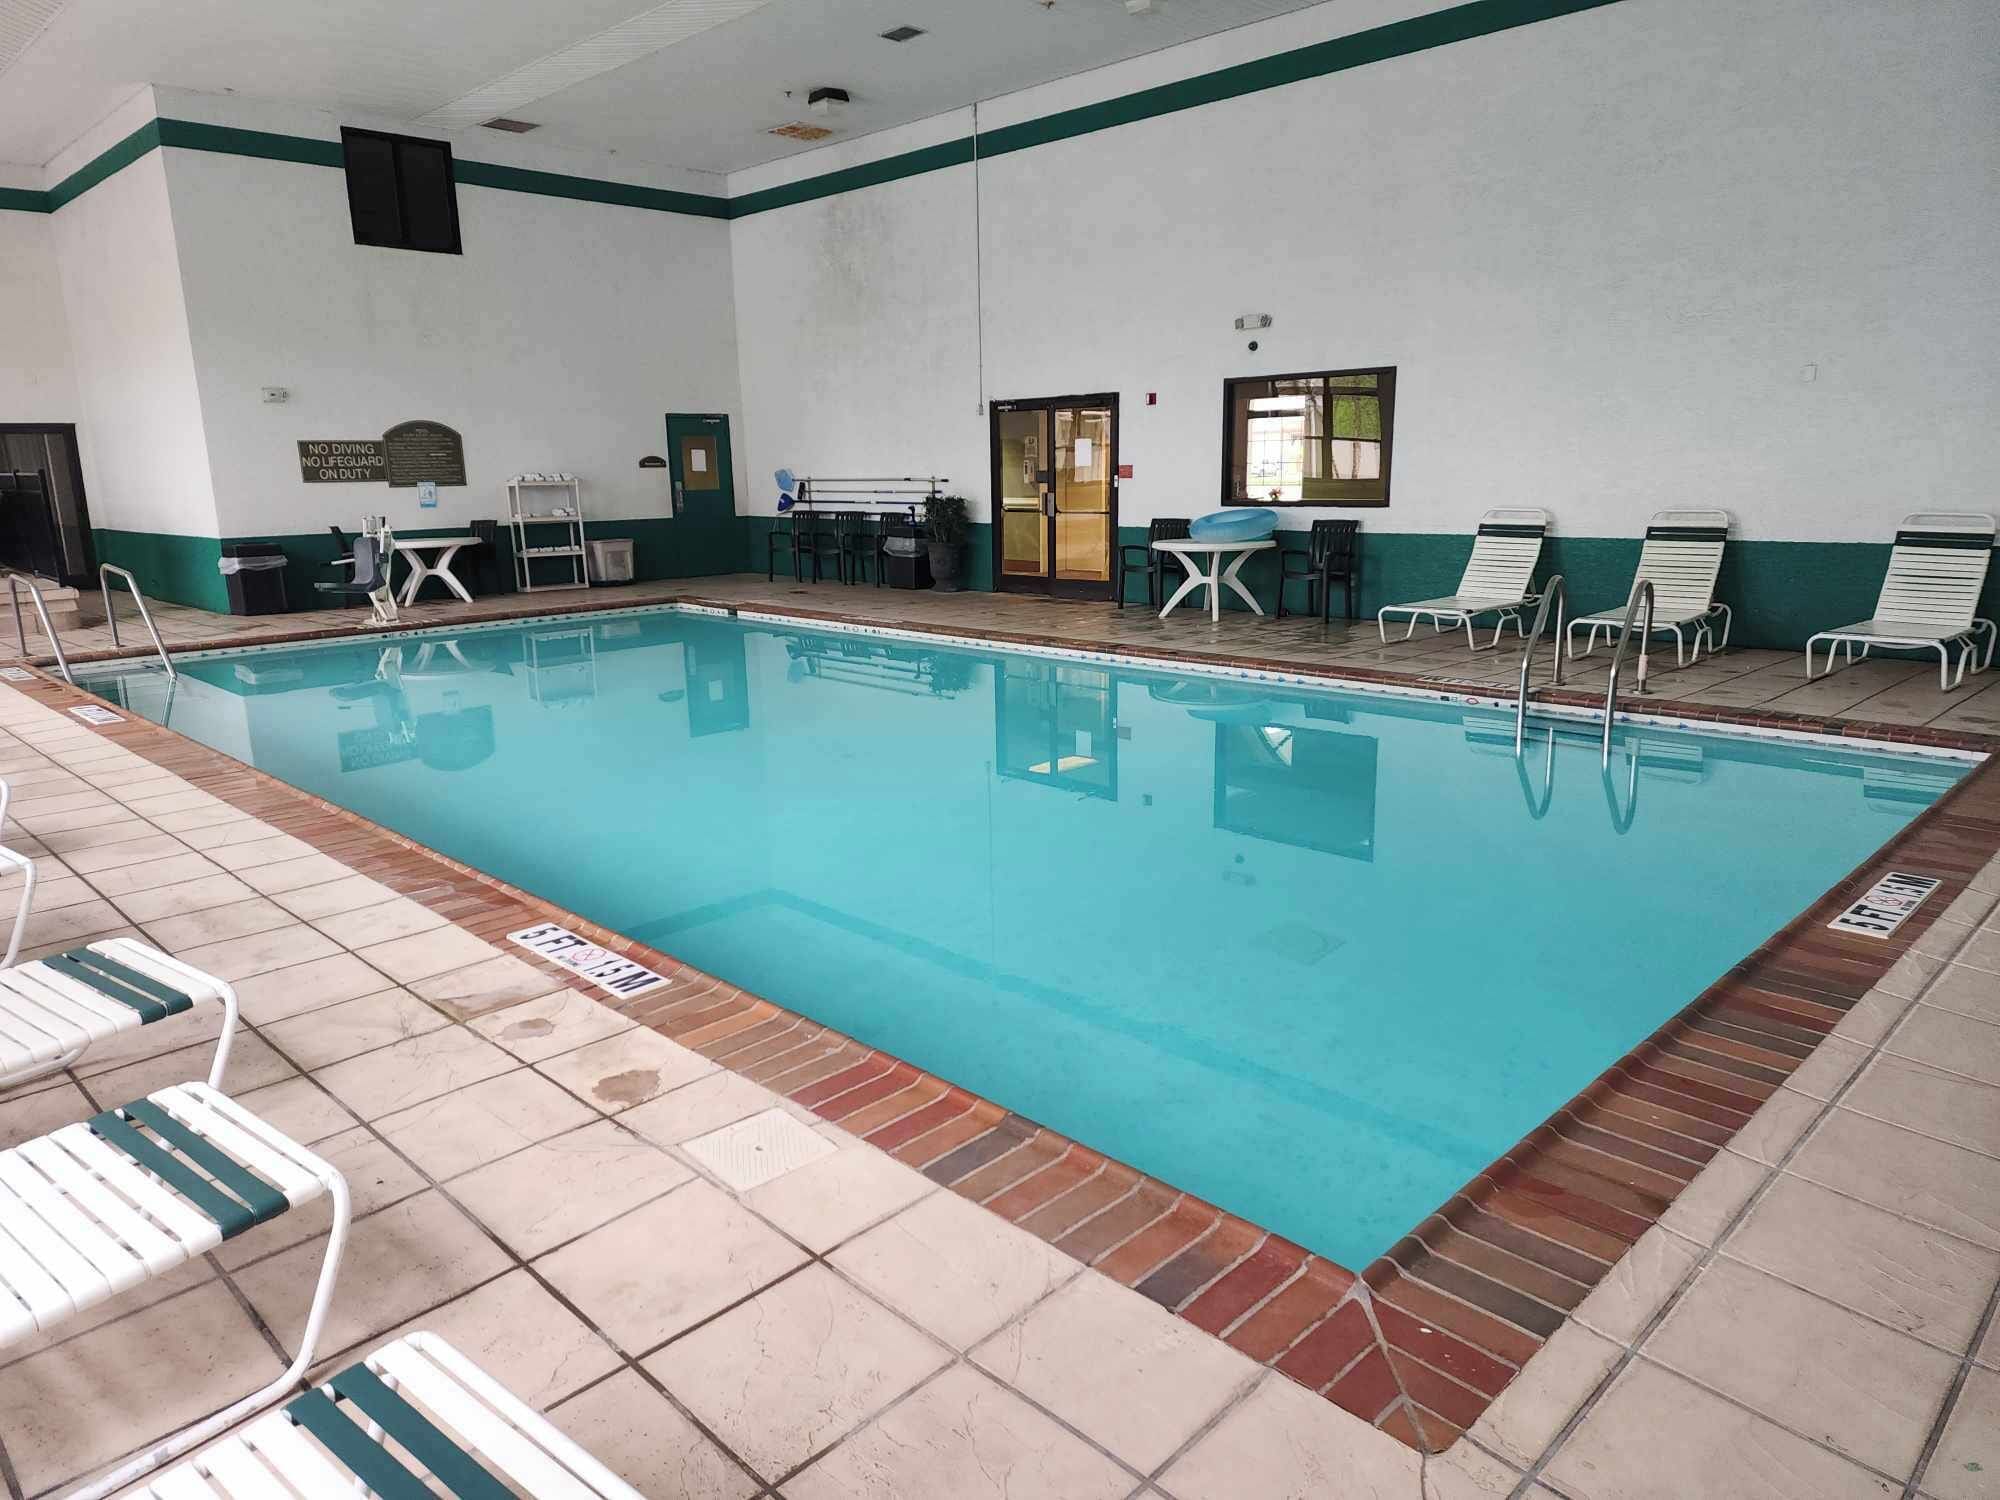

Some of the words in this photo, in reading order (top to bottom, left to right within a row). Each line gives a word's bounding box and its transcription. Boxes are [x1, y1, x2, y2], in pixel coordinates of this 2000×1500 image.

[308, 443, 329, 455] NO
[331, 443, 375, 455] DIVING
[301, 455, 320, 467] NO
[321, 455, 384, 467] LIFEGUARD
[319, 468, 338, 480] ON
[340, 468, 371, 479] DUTY
